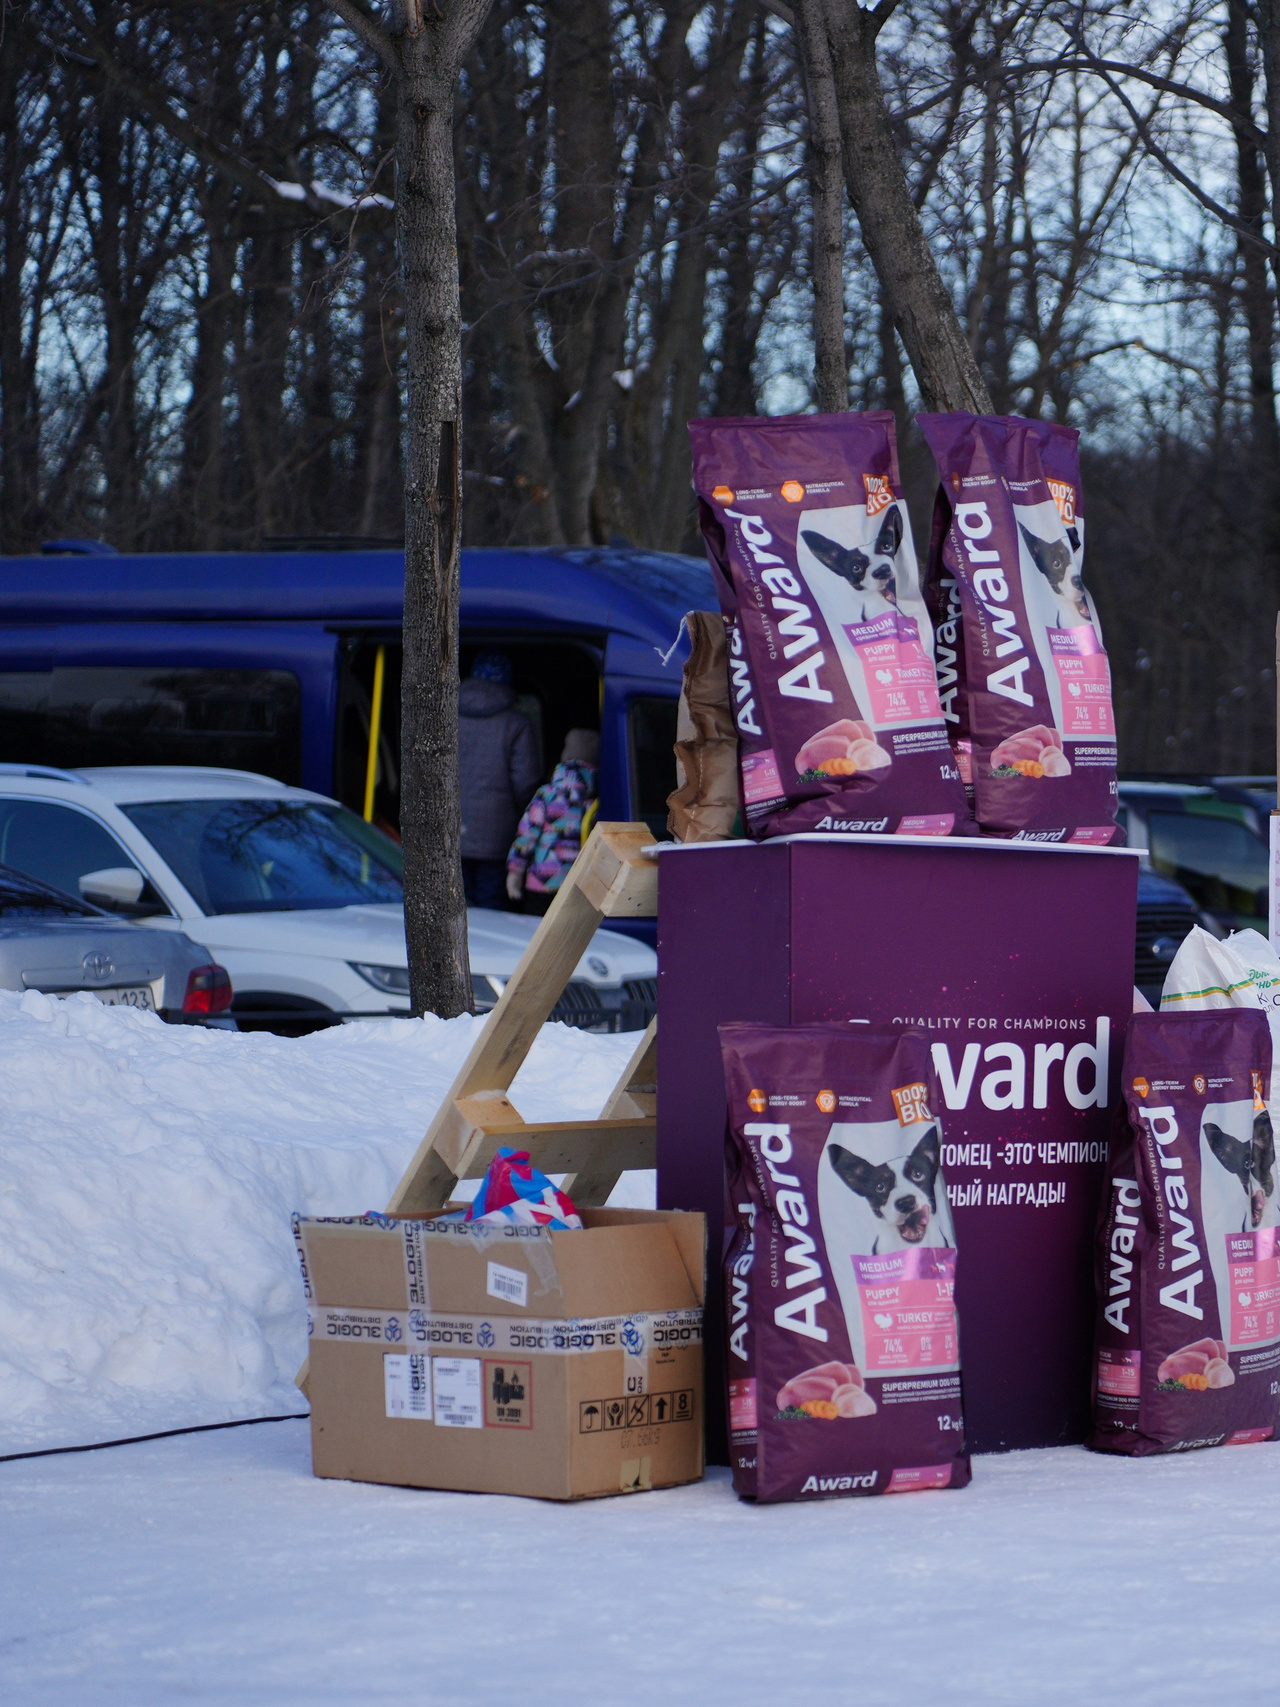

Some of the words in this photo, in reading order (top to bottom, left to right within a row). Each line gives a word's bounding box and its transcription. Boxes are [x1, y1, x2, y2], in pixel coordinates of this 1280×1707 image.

[866, 477, 886, 494] 100%
[867, 492, 892, 514] BIO
[753, 586, 766, 608] FOR
[955, 501, 1034, 707] Award
[724, 508, 833, 703] Award
[851, 618, 894, 636] MEDIUM
[975, 610, 989, 656] QUALITY
[761, 613, 778, 660] QUALITY
[863, 644, 895, 656] PUPPY
[1059, 659, 1083, 669] PUPPY
[887, 692, 906, 706] 74%
[1075, 706, 1089, 720] 74%
[893, 731, 938, 743] SUPERPREMIUM
[940, 765, 951, 779] 12
[1109, 781, 1116, 794] 12
[815, 816, 889, 832] Award
[1012, 827, 1067, 842] Award
[122, 990, 149, 1009] 123
[968, 1017, 997, 1029] FOR
[1004, 1018, 1086, 1030] CHAMPIONS
[896, 1086, 928, 1105] 100%
[901, 1103, 930, 1123] BIO
[940, 1145, 991, 1169] ТОМЕЦ
[1037, 1142, 1108, 1165] ЧЕМПИОН
[1145, 1125, 1161, 1192] CHAMPIONS
[748, 1139, 772, 1208] CHAMPIONS
[946, 1179, 982, 1208] НЫЙ
[987, 1182, 1066, 1208] НАГРАДЫ!
[1138, 1105, 1204, 1321] Award
[1156, 1195, 1164, 1218] FOR
[771, 1212, 779, 1234] FOR
[743, 1123, 829, 1343] Award
[1231, 1240, 1254, 1251] MEDIU
[404, 1223, 419, 1304] 3LOGIC
[770, 1237, 780, 1288] QUALITY
[1104, 1178, 1142, 1334] Award
[859, 1258, 902, 1273] MEDIUM
[865, 1287, 899, 1299] PUPPY
[326, 1314, 381, 1323] DISTRIBUTION
[416, 1320, 473, 1329] DISTRIBUTION
[897, 1312, 933, 1323] TURKEY
[1243, 1316, 1258, 1329] 74%
[327, 1323, 381, 1338] 3LOGIC
[416, 1330, 473, 1344] 3LOGIC
[653, 1327, 702, 1342] LOGIC
[553, 1333, 616, 1348] 3LOGIC
[883, 1339, 903, 1353] 74%
[920, 1336, 932, 1351] 0%
[1122, 1368, 1135, 1376] 1-15
[882, 1380, 938, 1392] SUPERPREMIUM
[1270, 1381, 1277, 1395] 12
[937, 1415, 951, 1430] 12
[801, 1470, 879, 1493] Award
